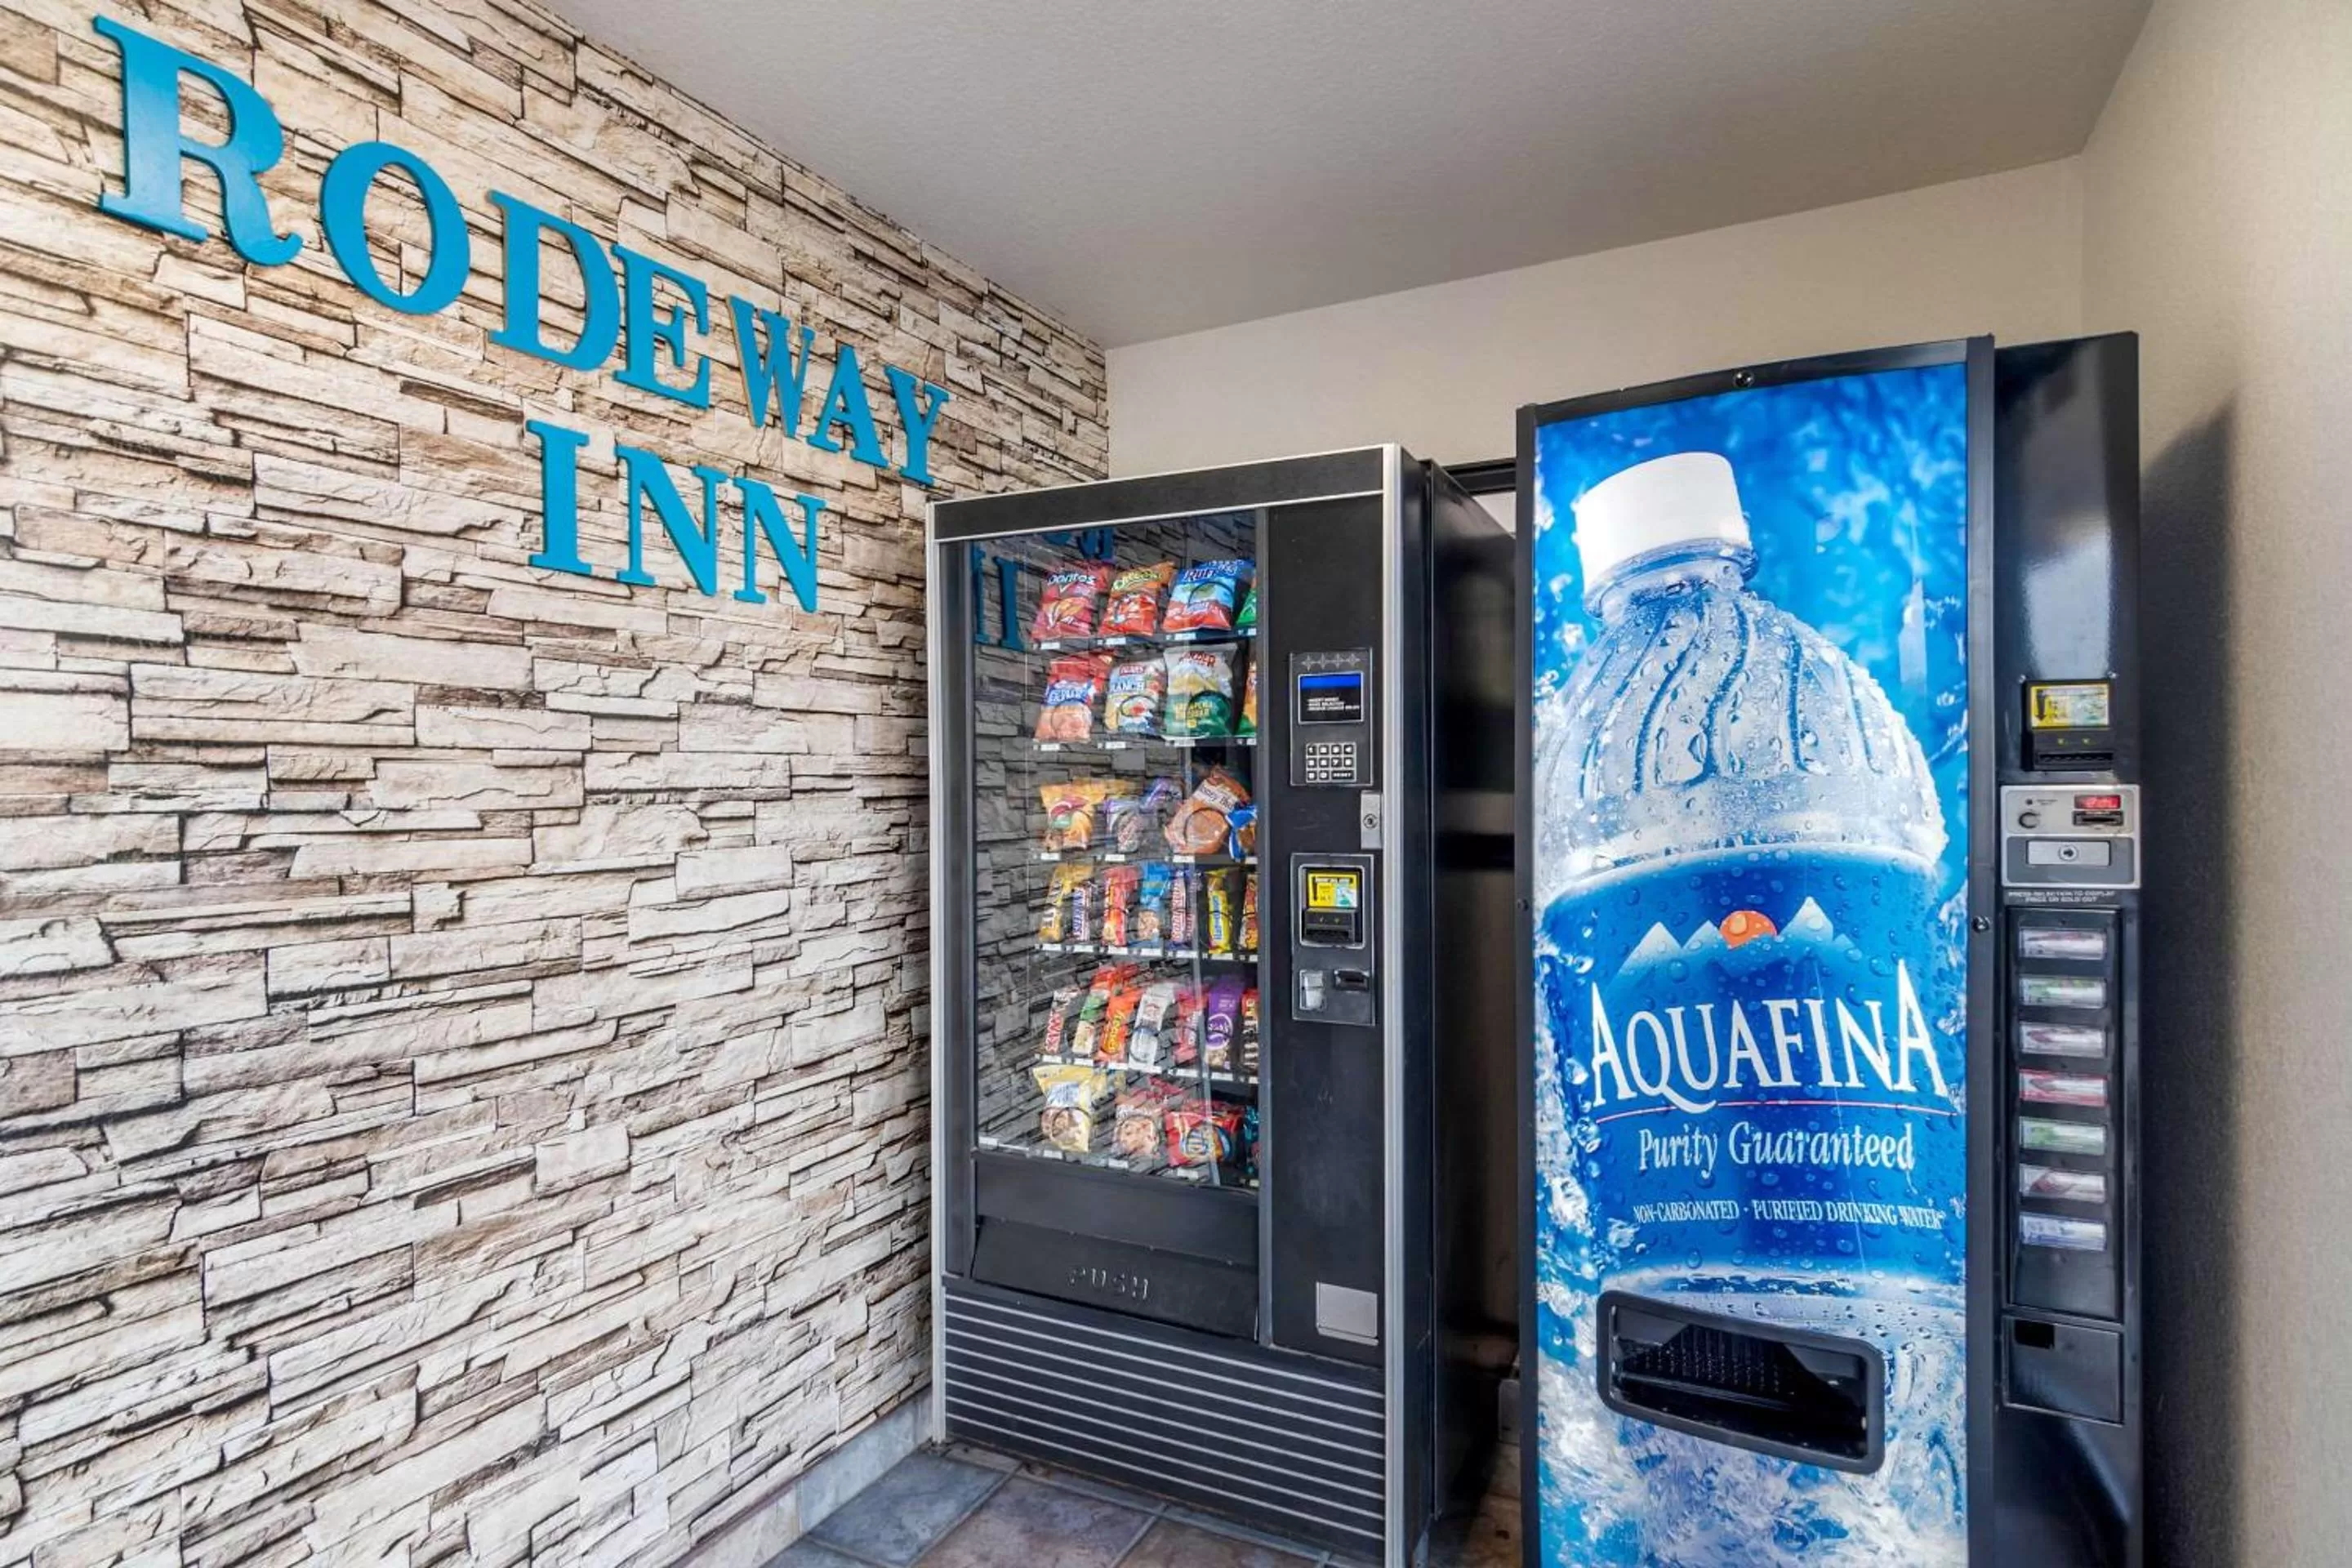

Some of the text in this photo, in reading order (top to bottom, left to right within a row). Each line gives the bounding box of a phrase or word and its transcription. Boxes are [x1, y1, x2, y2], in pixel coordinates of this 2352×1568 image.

[93, 14, 950, 488] RODEWAY
[526, 419, 826, 614] INN
[1592, 959, 1947, 1114] AQUAFINA
[1634, 1200, 1740, 1223] NON-CARBONATED
[1752, 1200, 1823, 1221] PURIFIED
[1826, 1200, 1898, 1225] DRINKING
[1639, 1121, 1915, 1178] Purity Guaranteed
